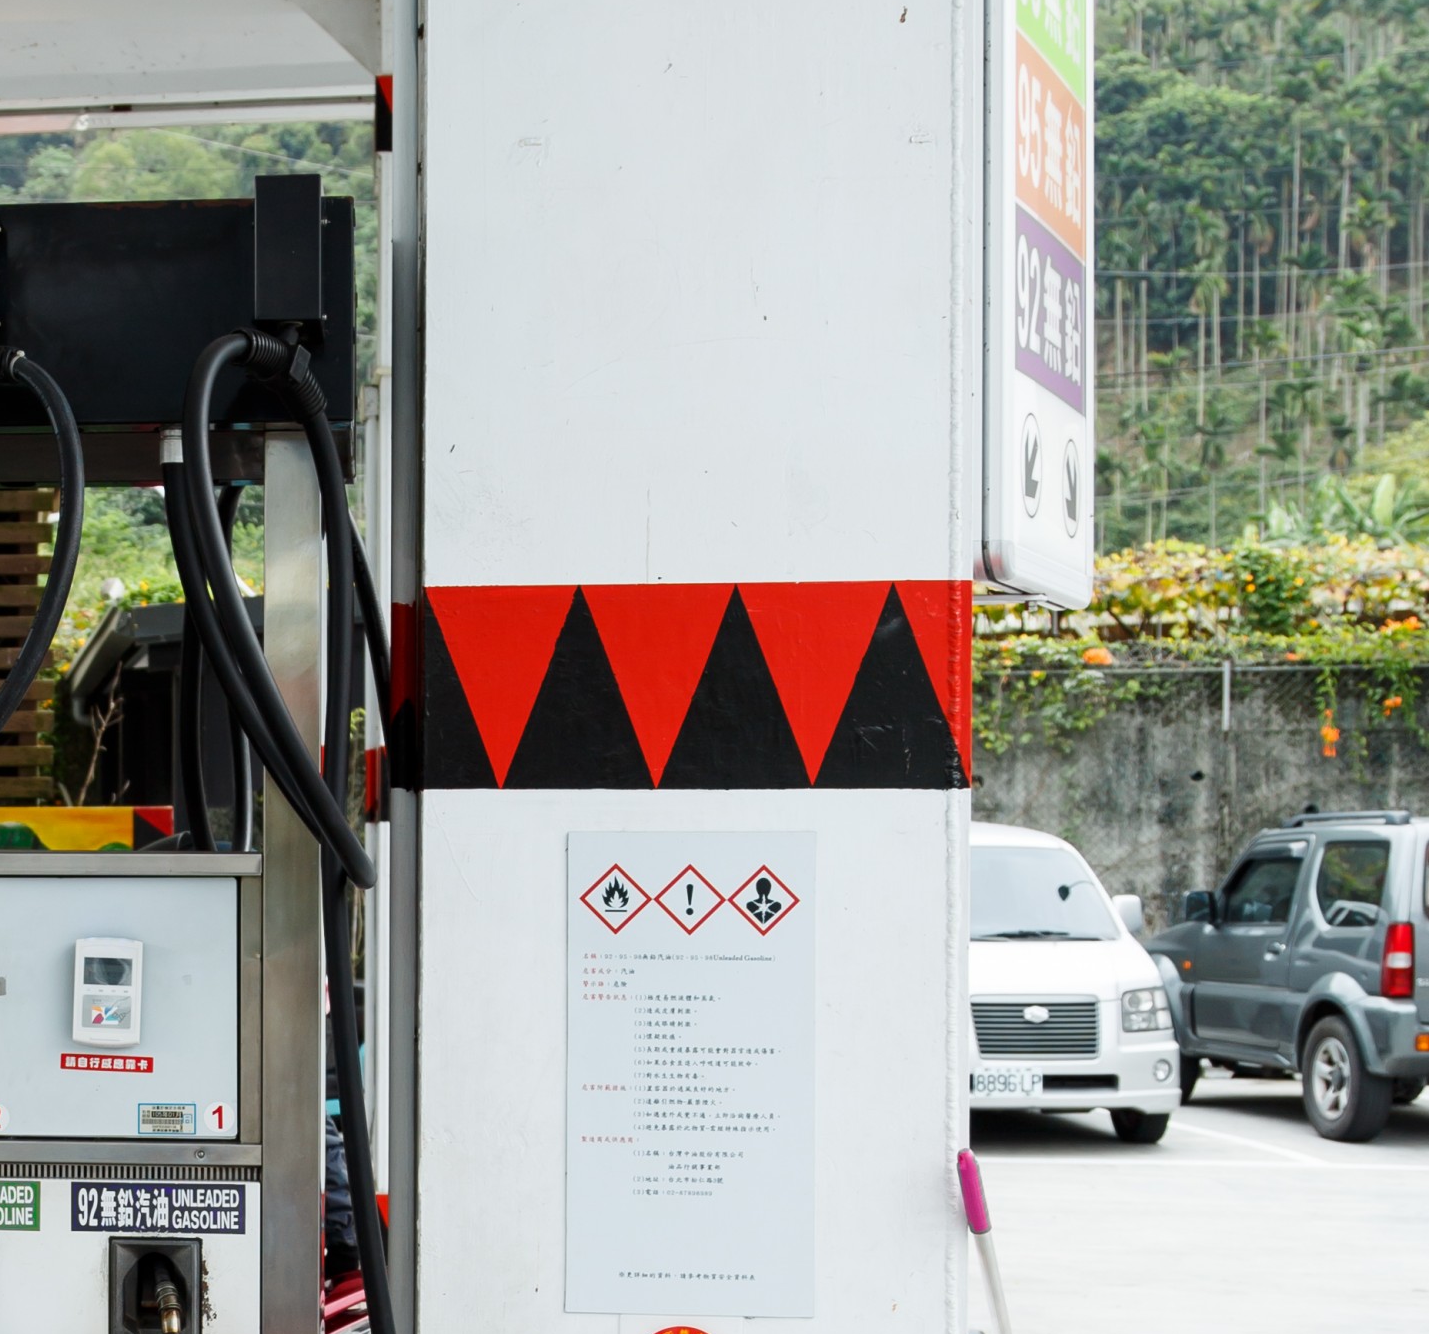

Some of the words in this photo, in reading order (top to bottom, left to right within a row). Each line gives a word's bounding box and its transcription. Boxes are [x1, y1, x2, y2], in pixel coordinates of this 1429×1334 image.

[1018, 63, 1081, 228] 95無鉛
[1018, 234, 1081, 386] 92無鉛
[212, 1105, 224, 1129] 1
[78, 1187, 169, 1229] 92無鉛汽油
[172, 1189, 240, 1208] UNLEADED
[172, 1211, 240, 1231] GASOLINE
